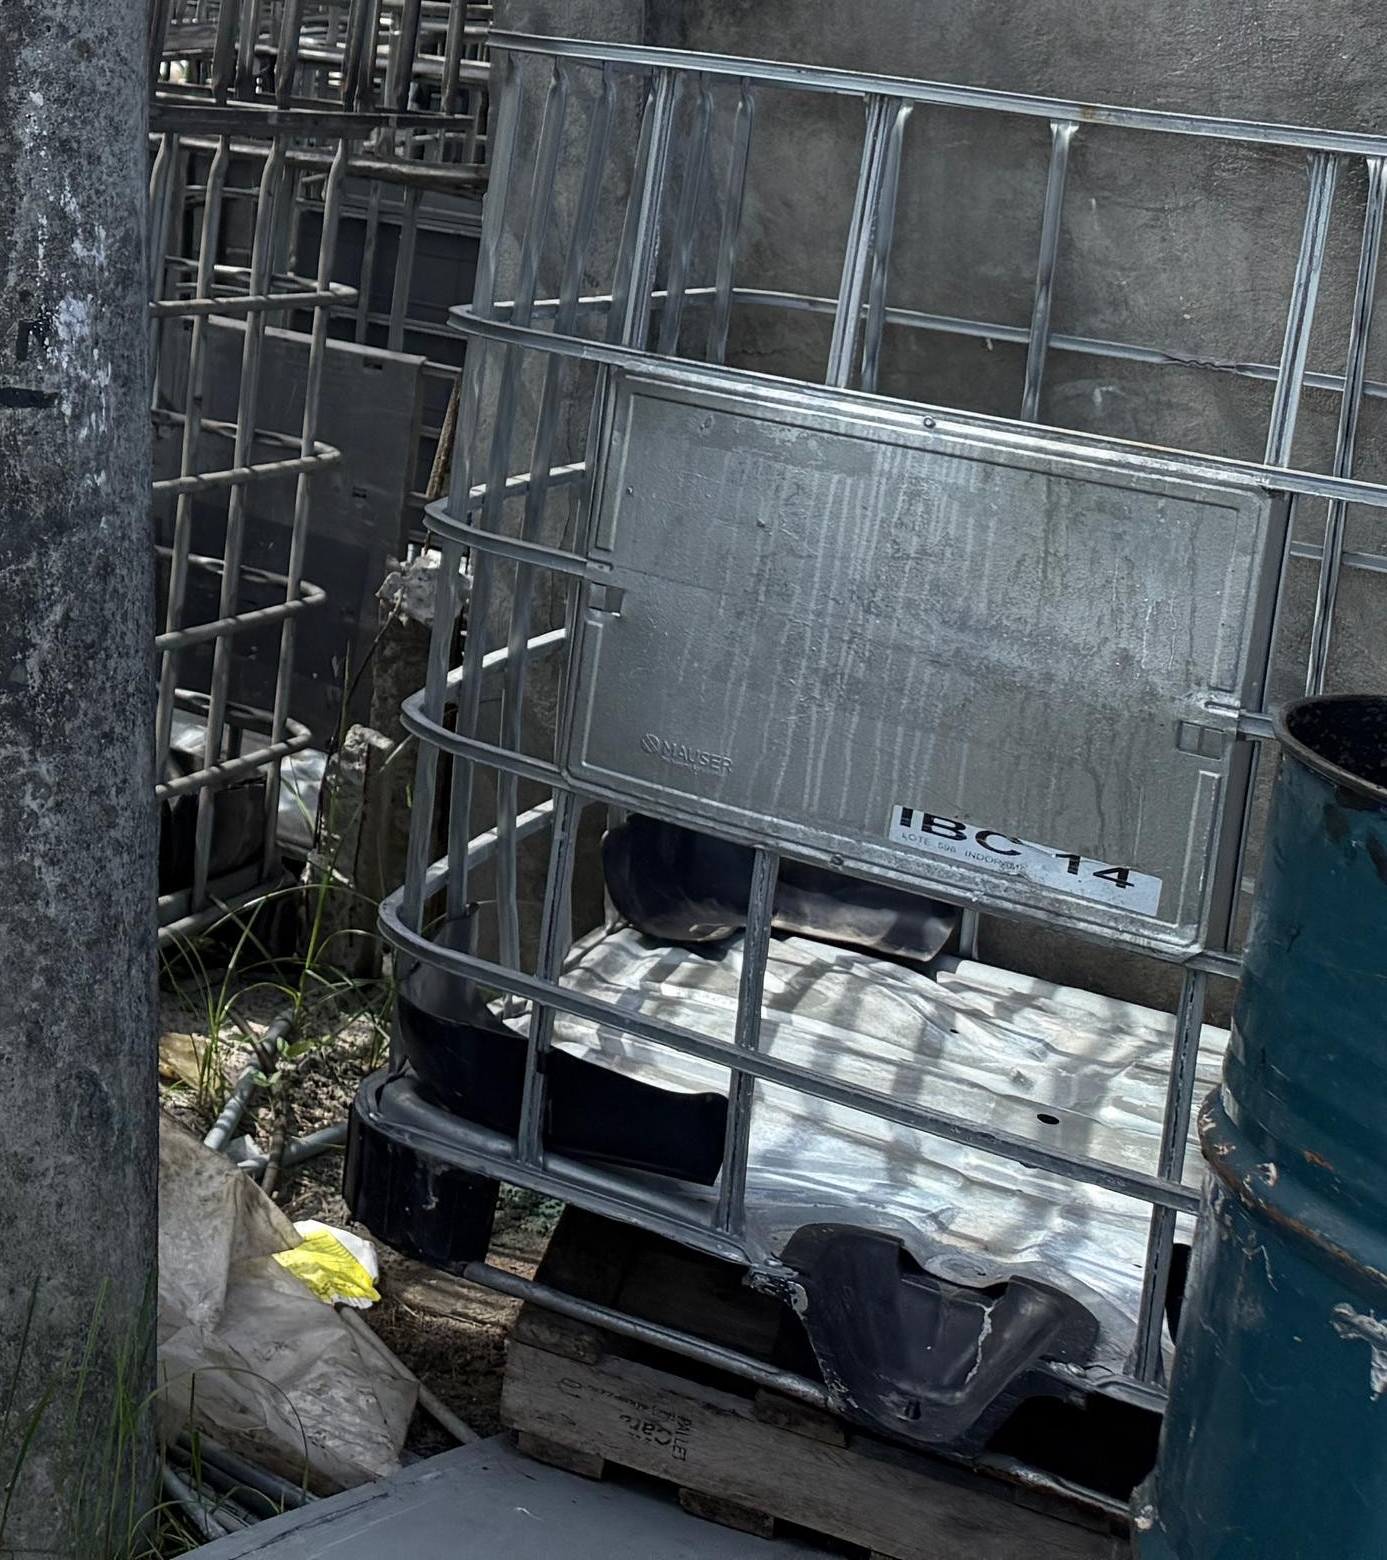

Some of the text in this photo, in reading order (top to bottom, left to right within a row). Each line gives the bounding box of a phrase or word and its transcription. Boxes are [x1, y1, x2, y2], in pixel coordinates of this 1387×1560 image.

[661, 740, 733, 773] MAUSER
[900, 807, 1135, 889] IBC 14
[672, 1416, 693, 1462] PALLET
